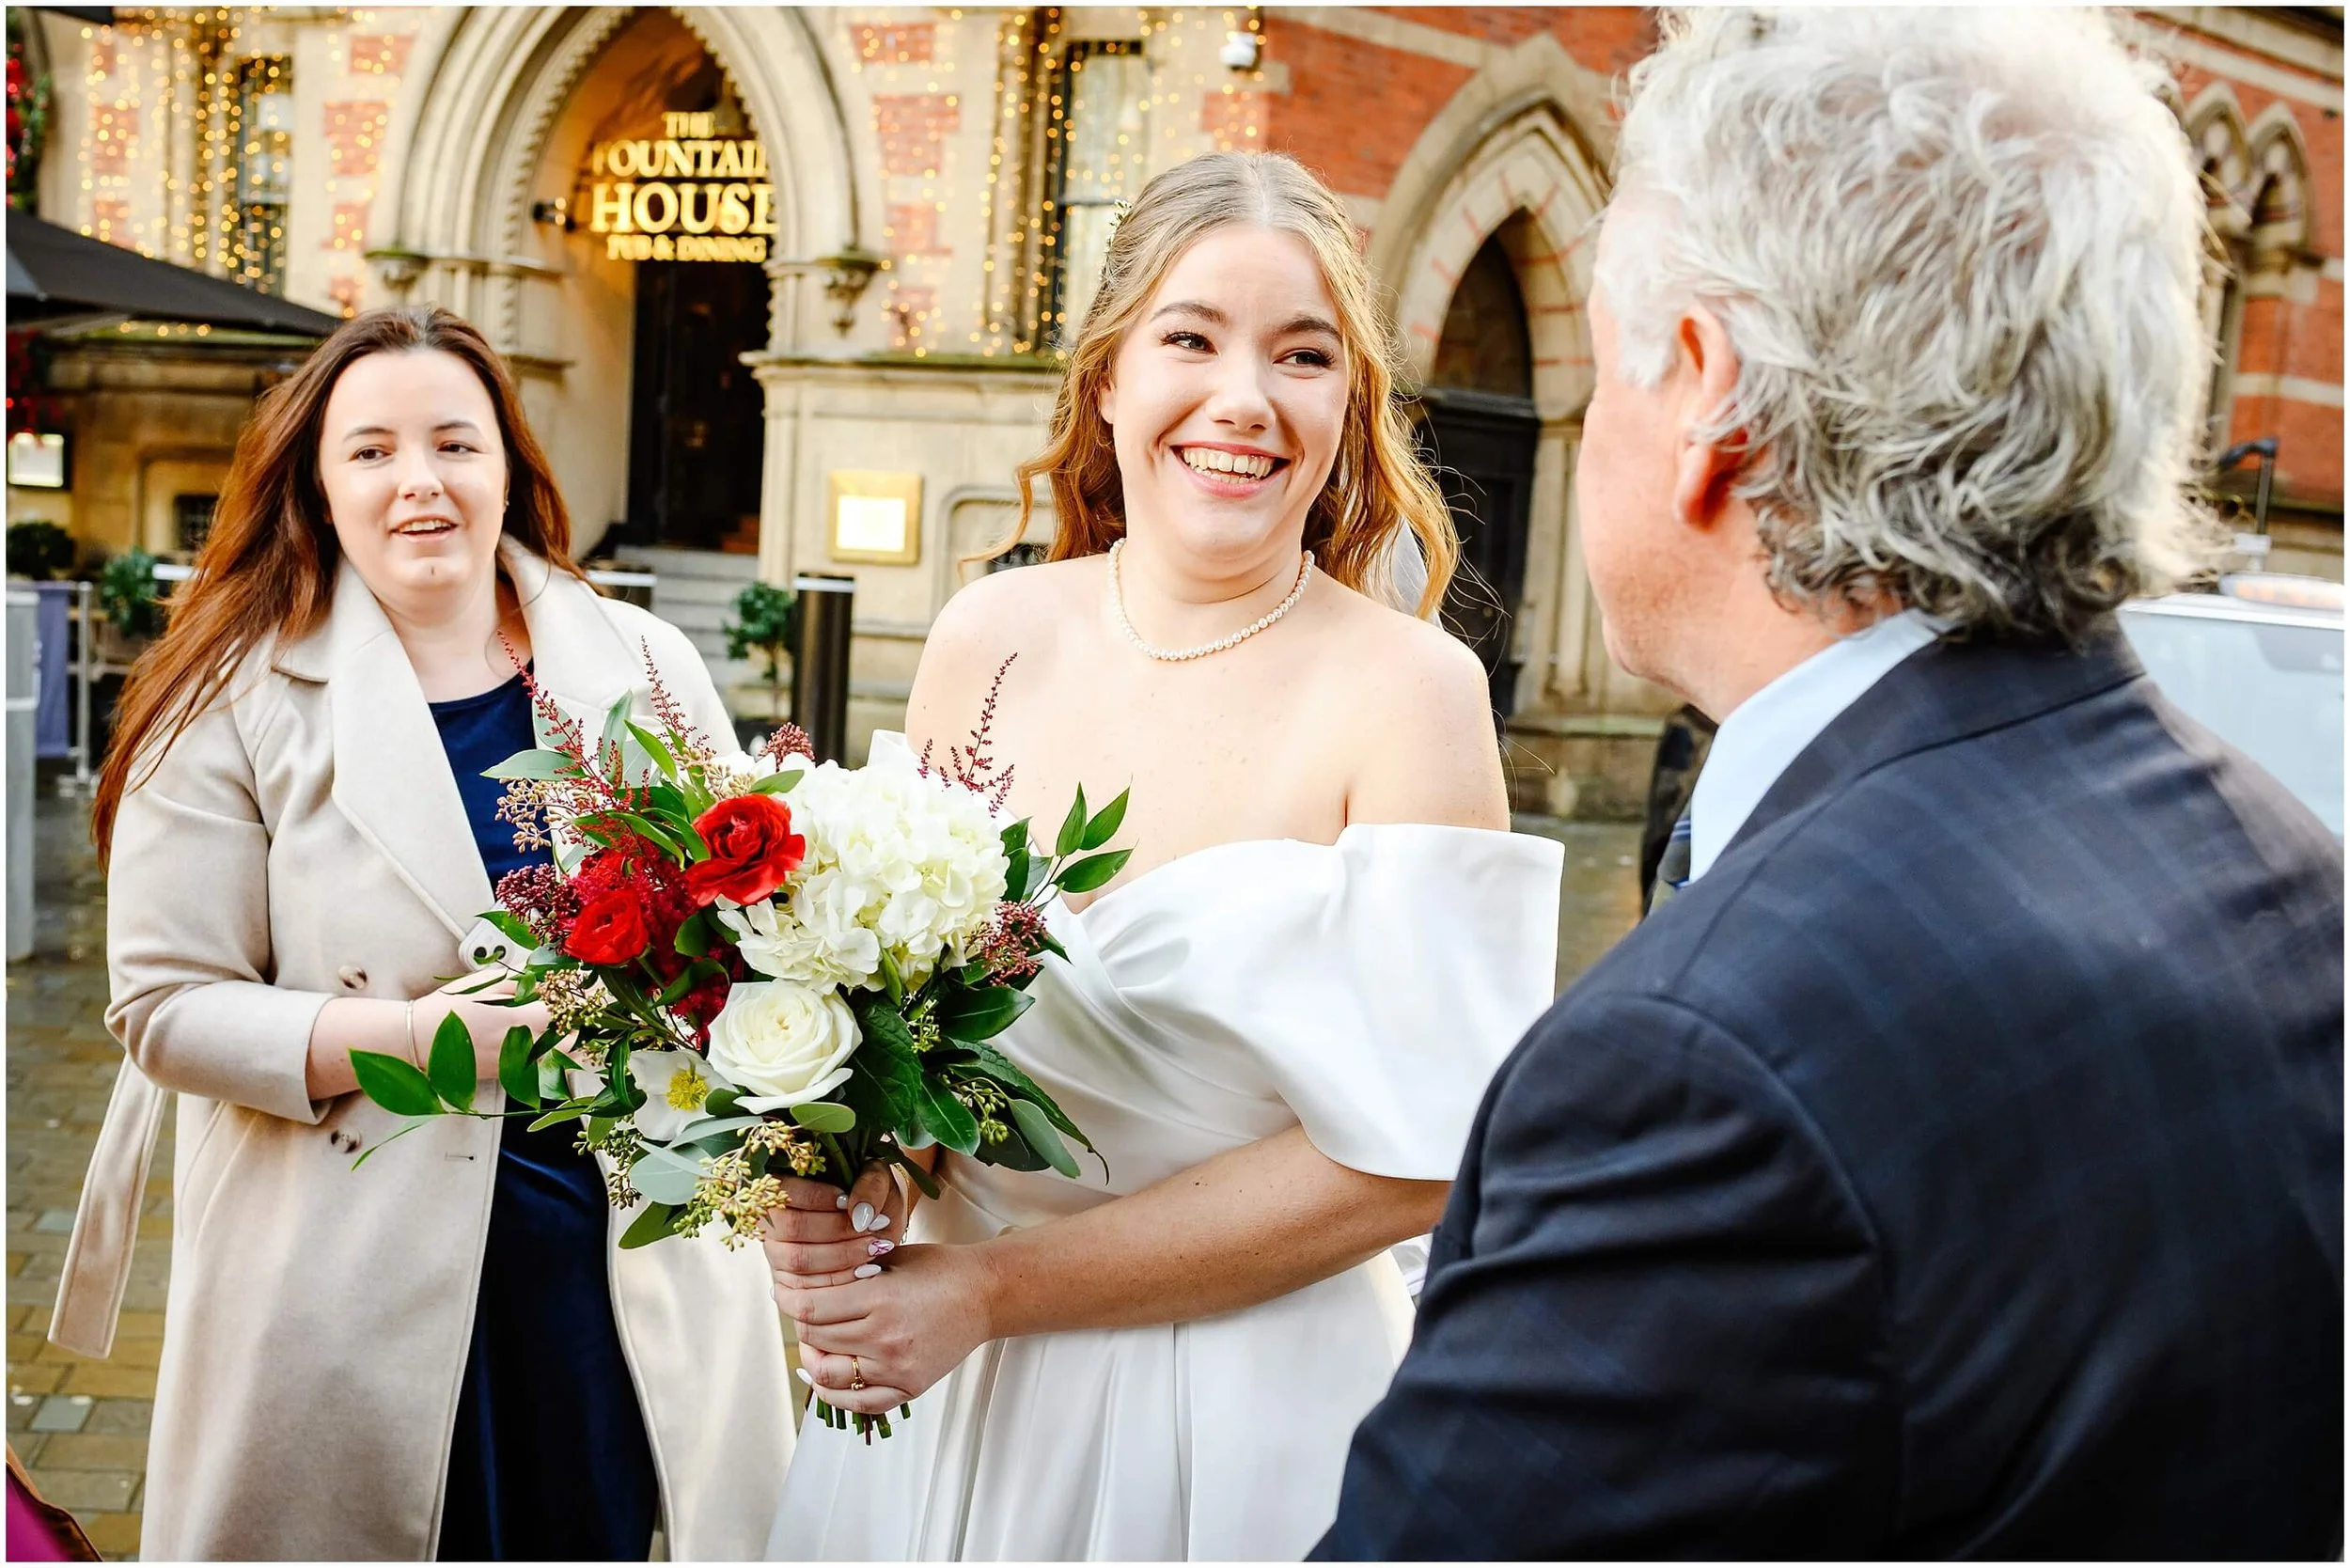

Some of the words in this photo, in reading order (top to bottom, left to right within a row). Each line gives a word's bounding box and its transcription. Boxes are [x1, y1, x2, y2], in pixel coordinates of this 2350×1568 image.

[662, 111, 715, 138] THE
[589, 181, 780, 234] HOUSE
[606, 235, 652, 260] PUB
[652, 234, 676, 260] &
